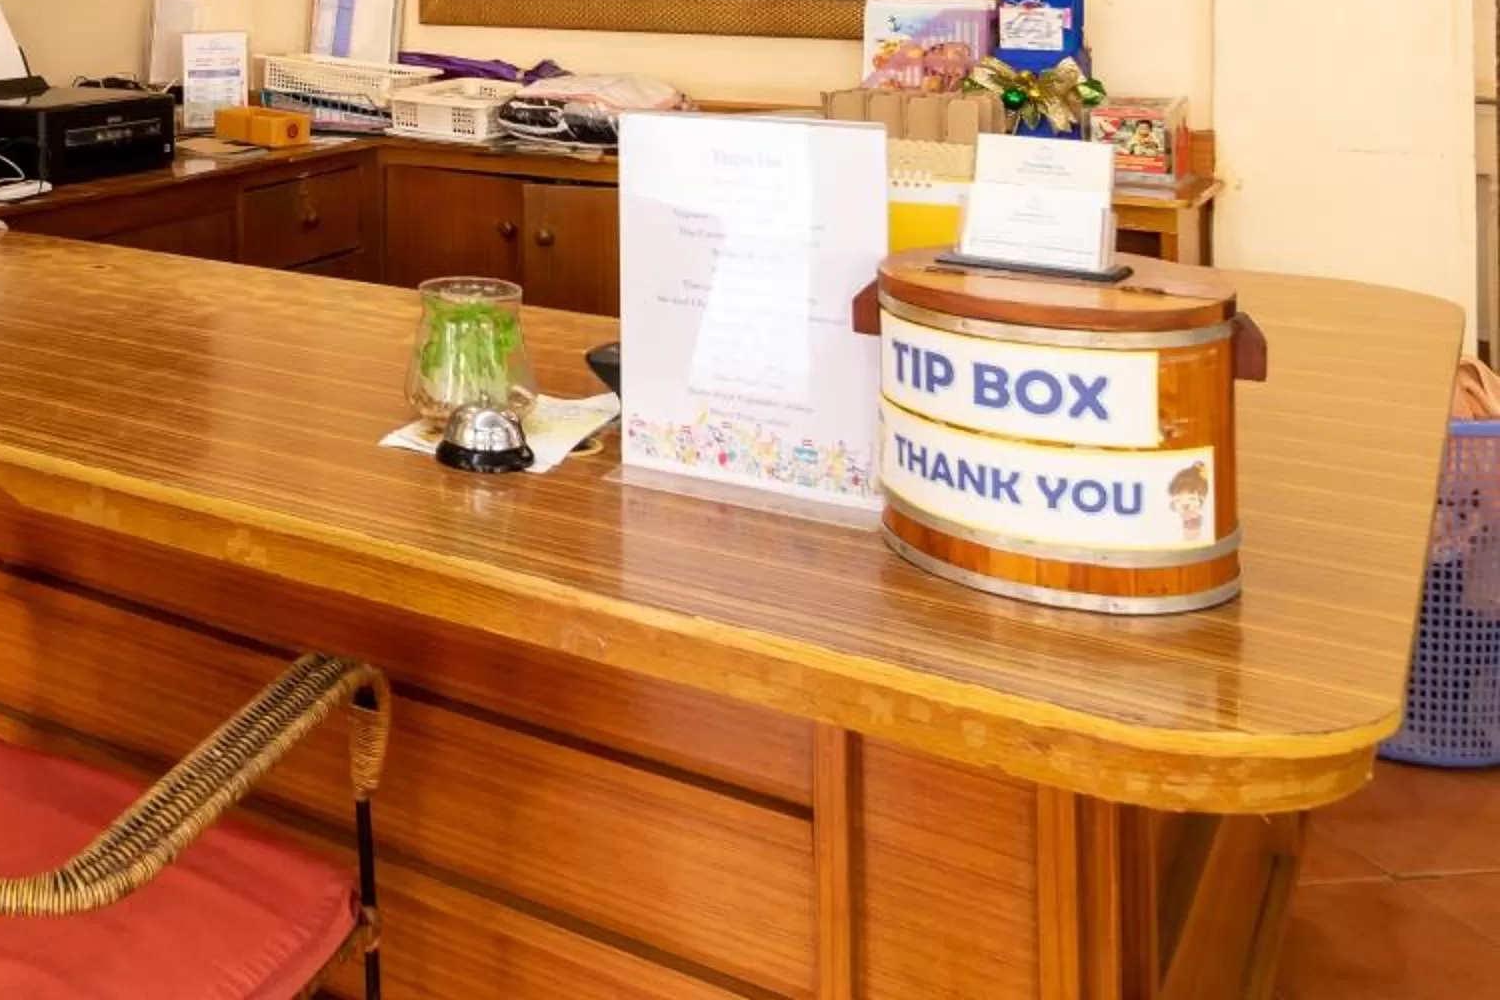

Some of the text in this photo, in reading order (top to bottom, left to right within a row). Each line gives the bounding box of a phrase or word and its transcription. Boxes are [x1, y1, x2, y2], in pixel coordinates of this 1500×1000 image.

[892, 340, 1109, 421] TIP BOX
[894, 433, 1143, 516] THANK YOU
